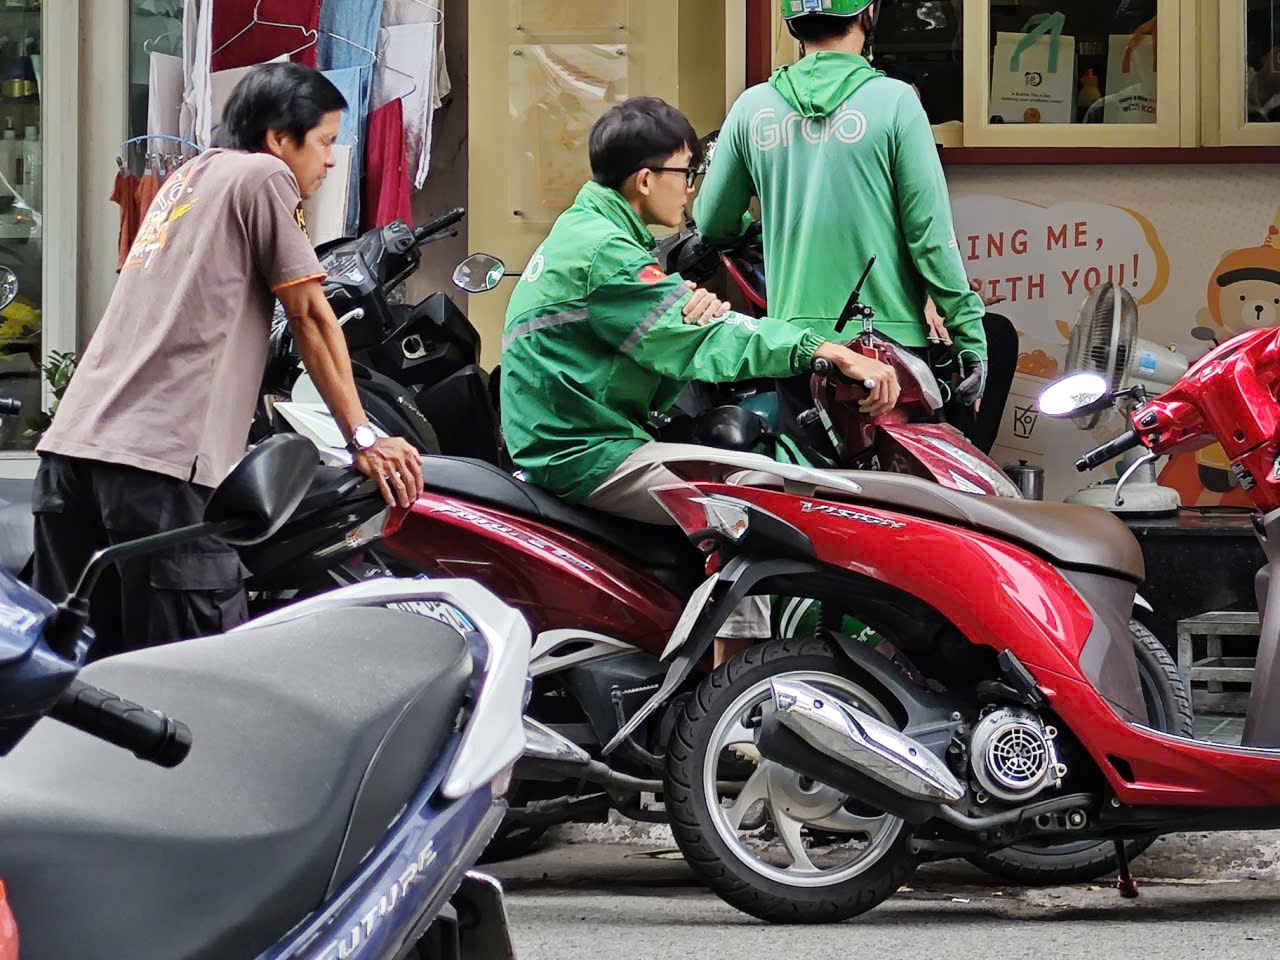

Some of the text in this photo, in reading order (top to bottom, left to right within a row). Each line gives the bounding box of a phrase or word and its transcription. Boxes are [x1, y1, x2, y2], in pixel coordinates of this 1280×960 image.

[1047, 221, 1104, 251] ME,
[981, 274, 1045, 302] ITH
[800, 500, 907, 529] VISION
